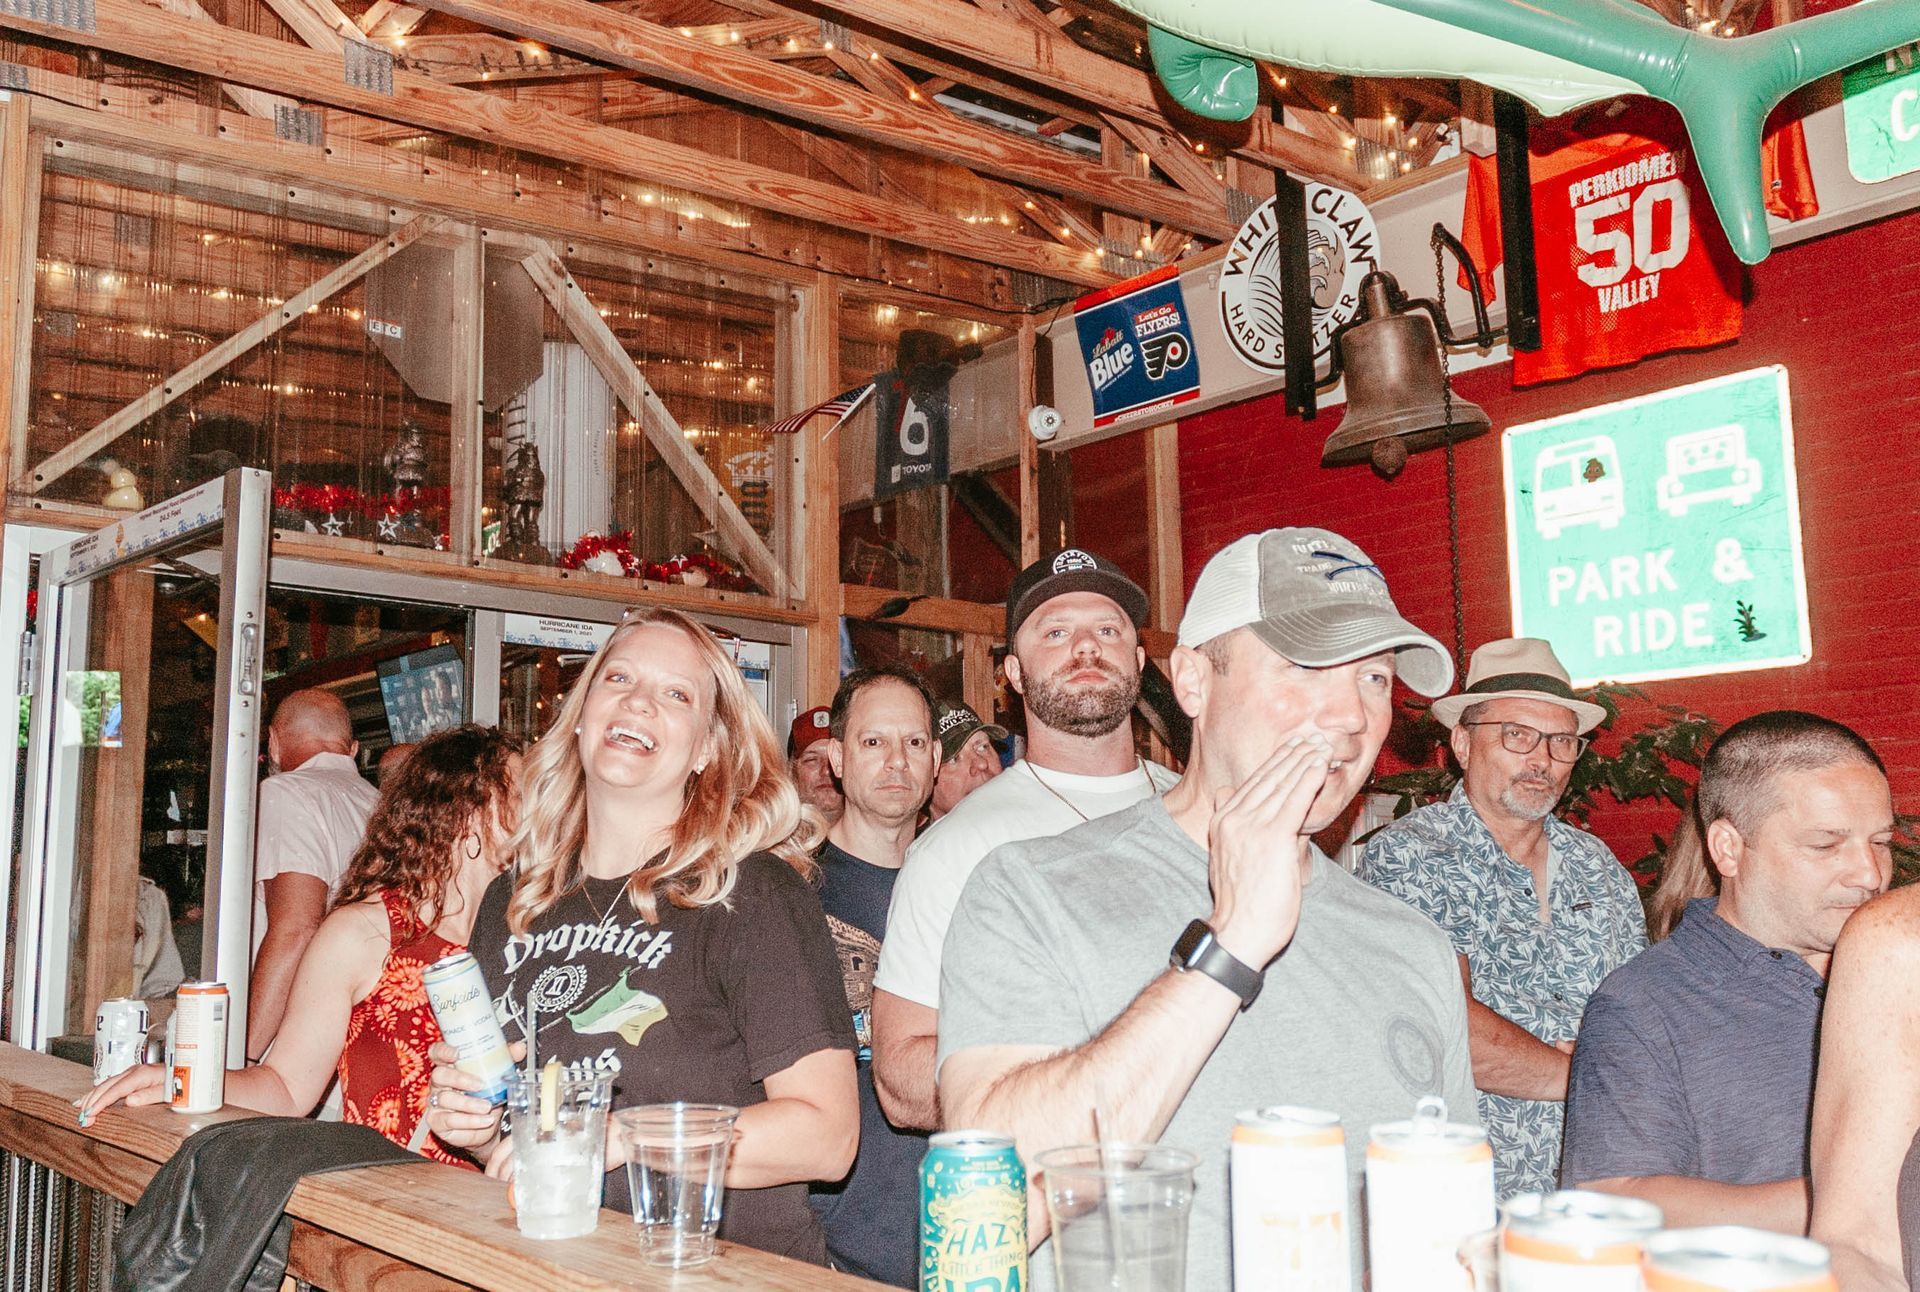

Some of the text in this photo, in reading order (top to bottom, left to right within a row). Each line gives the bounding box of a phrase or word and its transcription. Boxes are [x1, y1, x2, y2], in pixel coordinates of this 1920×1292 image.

[1569, 149, 1687, 208] PERKIOMEN
[1311, 188, 1374, 264] CLAW
[1575, 178, 1691, 288] 50
[1138, 306, 1172, 323] Let's Go
[1598, 272, 1660, 313] VALLEY
[373, 321, 398, 335] ETC
[1135, 311, 1182, 338] FLYERS!
[1230, 293, 1357, 359] HARD STZER
[1089, 342, 1134, 390] Blue
[1548, 537, 1754, 607] PARK &
[539, 619, 580, 629] HURRICANE
[1593, 602, 1715, 658] RIDE
[504, 915, 673, 974] Dropkick
[946, 1222, 1021, 1256] HAZY
